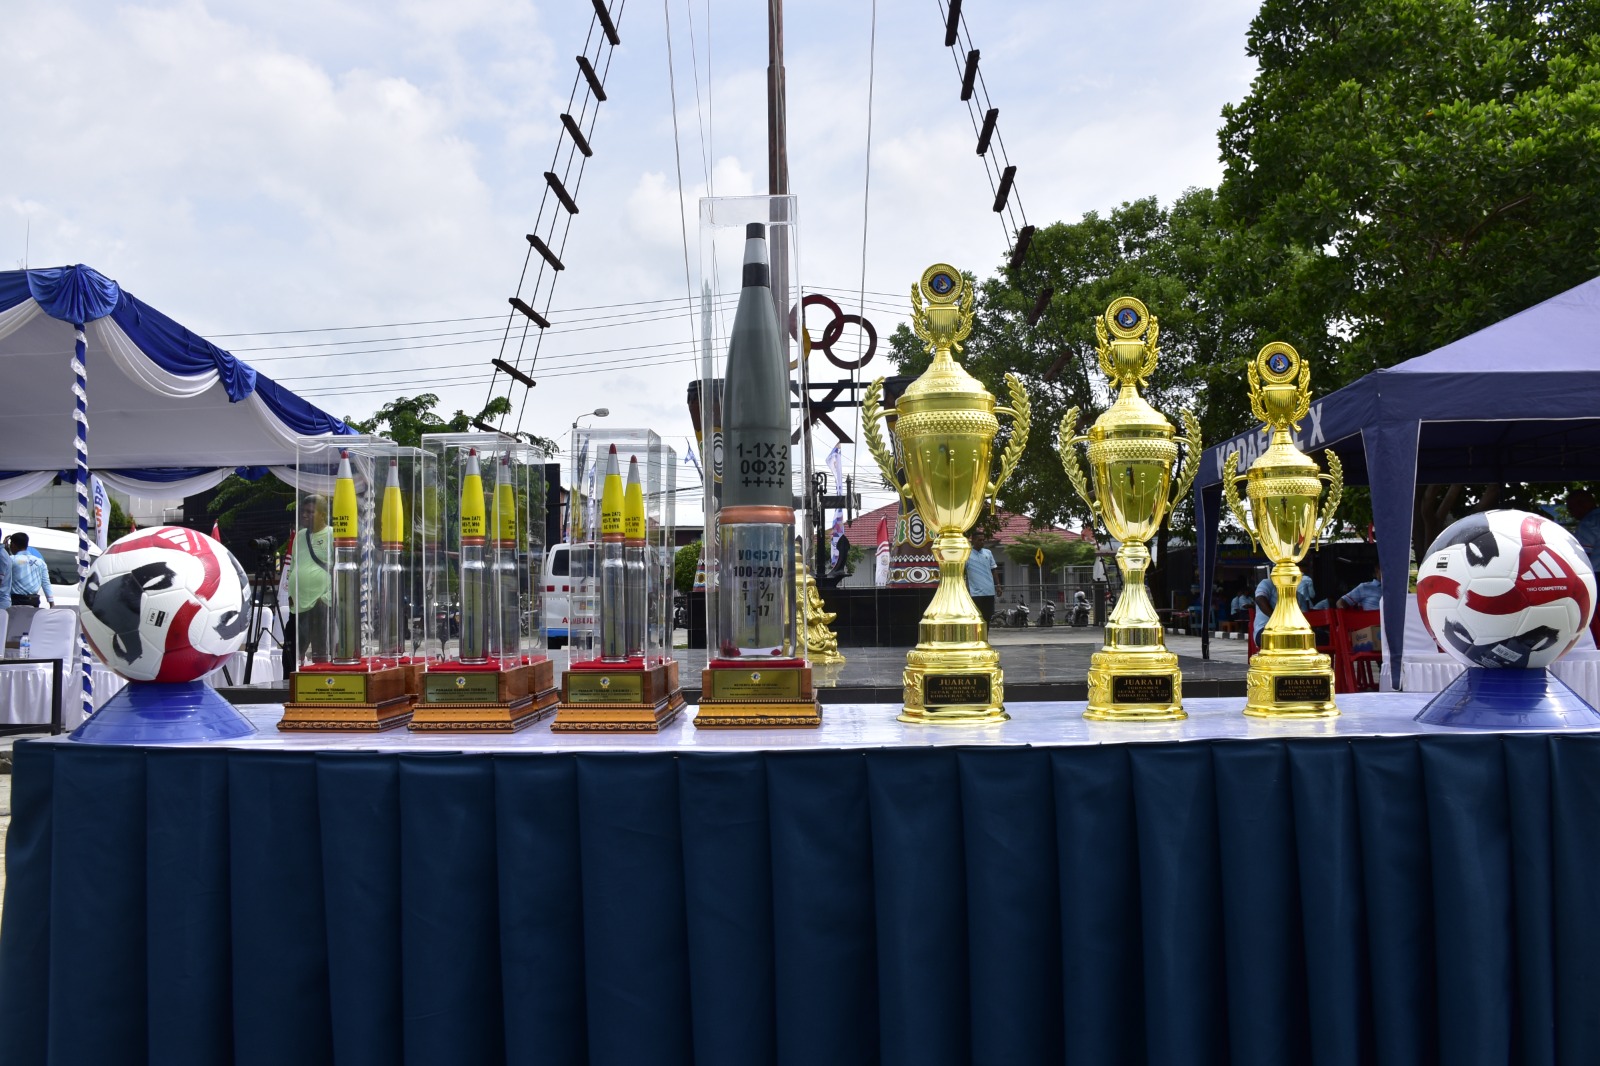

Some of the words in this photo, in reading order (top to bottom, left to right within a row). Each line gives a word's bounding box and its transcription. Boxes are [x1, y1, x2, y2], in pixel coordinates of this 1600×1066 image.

[1216, 420, 1304, 480] KODAEL
[1309, 402, 1326, 447] X
[733, 565, 784, 578] 100-2A70
[746, 604, 770, 617] 1-17
[939, 678, 971, 686] JUARA
